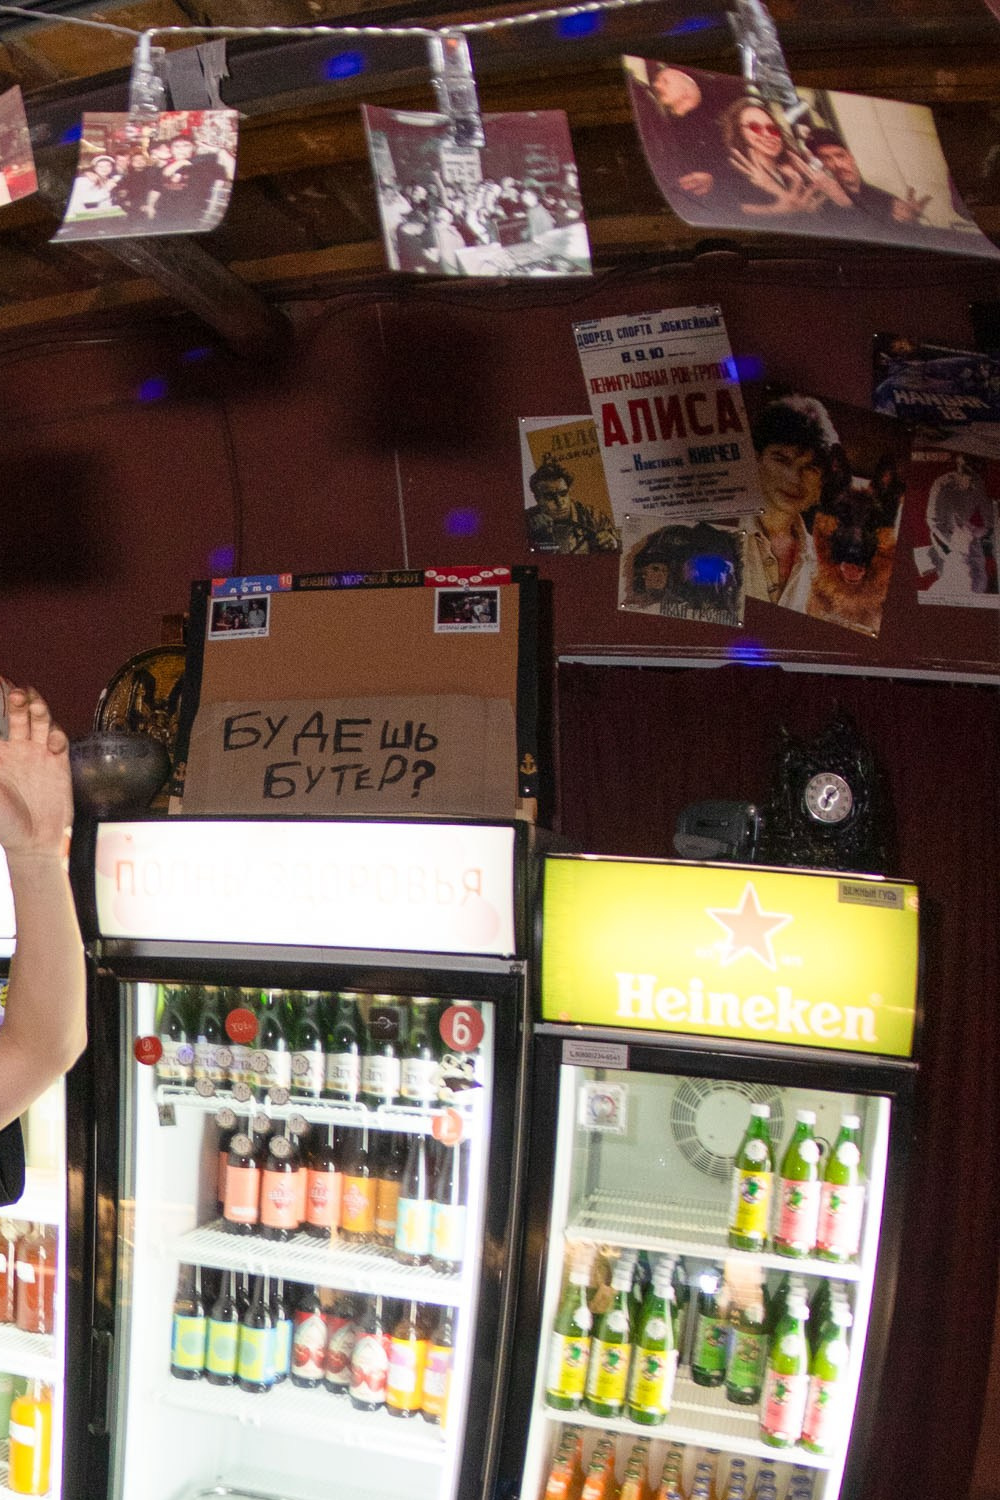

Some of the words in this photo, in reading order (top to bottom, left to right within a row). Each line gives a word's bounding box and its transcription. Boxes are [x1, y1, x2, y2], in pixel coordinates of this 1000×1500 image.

[576, 329, 614, 347] ДВОРЕЦ
[616, 323, 652, 339] СПОРТА
[589, 370, 669, 395] ЛЕНИНГРАДСКАЯ
[601, 389, 744, 448] АЛИСА
[223, 710, 439, 756] БУДЕШЬ
[262, 754, 437, 800] БУТЕР?
[450, 1010, 474, 1044] 6
[614, 971, 879, 1042] Heineken
